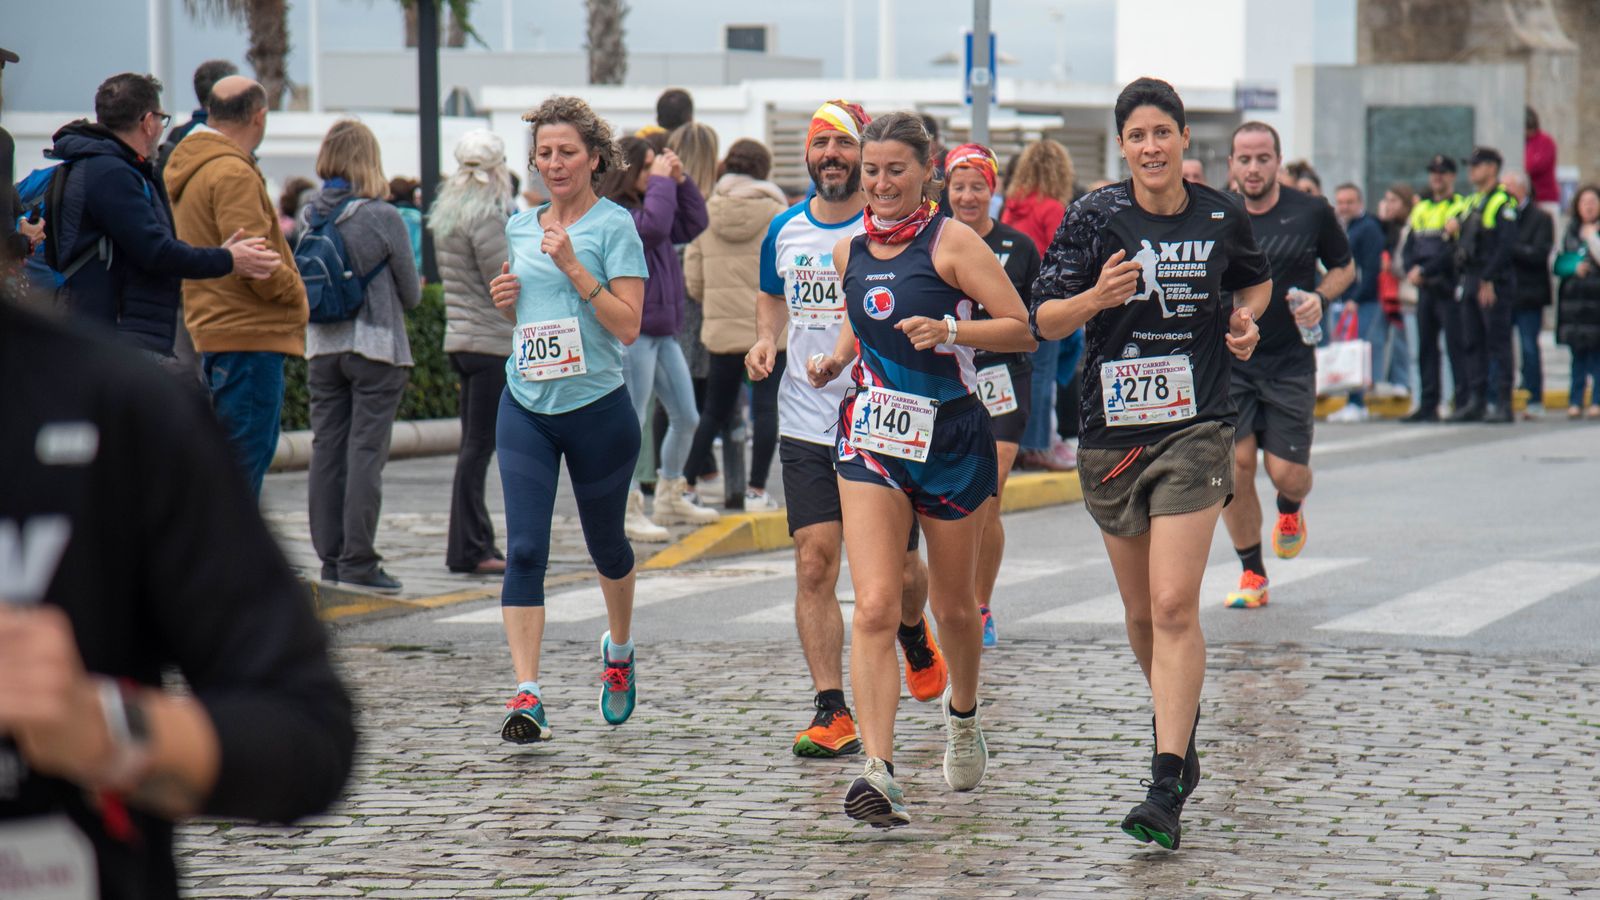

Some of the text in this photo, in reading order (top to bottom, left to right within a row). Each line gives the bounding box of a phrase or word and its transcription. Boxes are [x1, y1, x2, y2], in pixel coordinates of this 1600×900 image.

[1159, 240, 1215, 262] XIV
[796, 270, 816, 281] XIV
[1158, 270, 1206, 278] ESTRECHO
[801, 281, 838, 304] 204
[523, 327, 536, 338] XIV
[1132, 330, 1193, 341] metrovacesa
[527, 336, 561, 361] 205
[1115, 361, 1171, 378] XIV CARRERA
[1156, 366, 1187, 375] ESTRECHO
[1123, 375, 1169, 403] 278
[869, 391, 919, 406] XIV CARRERA
[902, 404, 933, 415] ESTRECHO
[873, 405, 911, 435] 140
